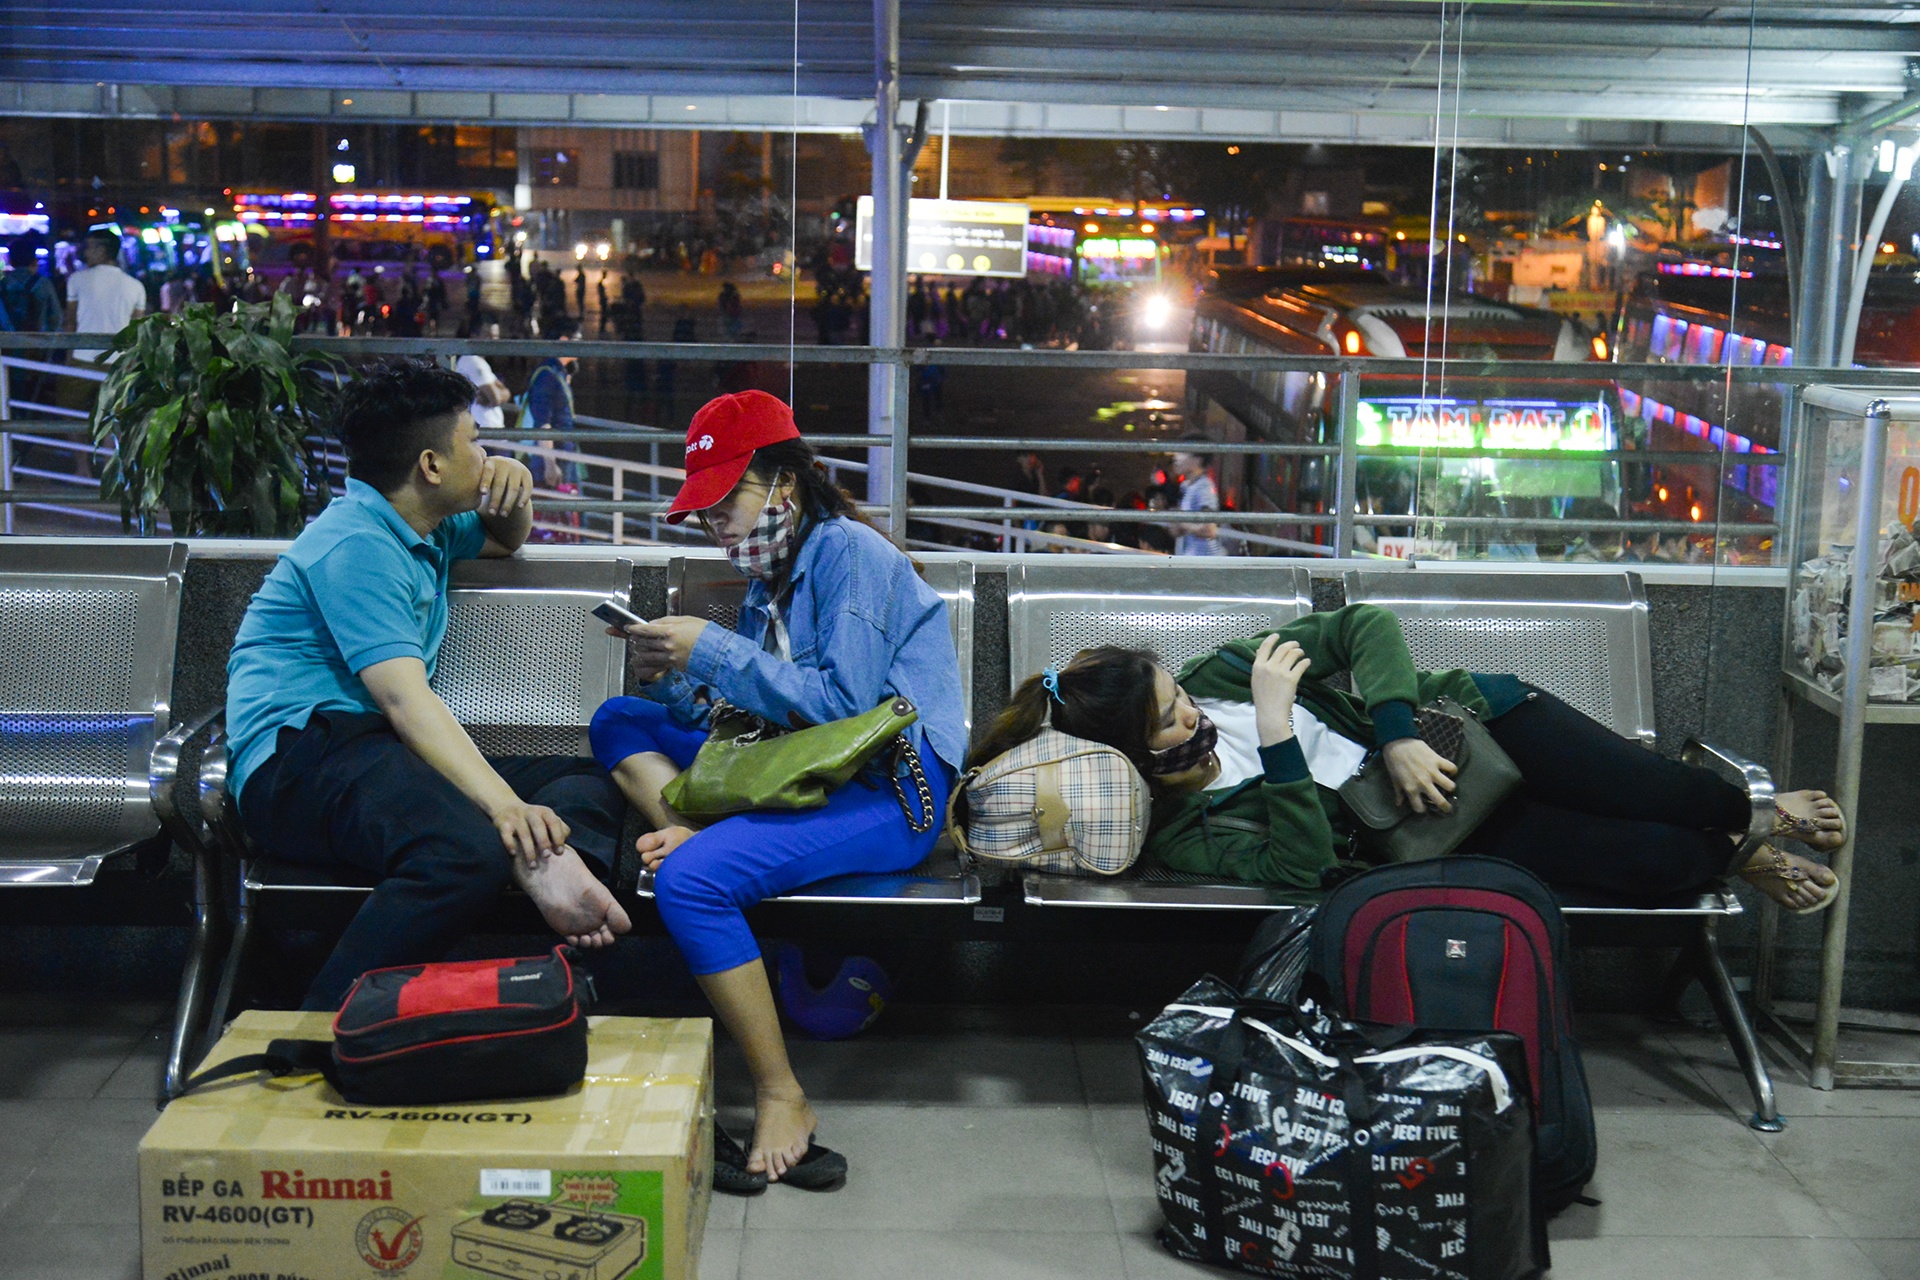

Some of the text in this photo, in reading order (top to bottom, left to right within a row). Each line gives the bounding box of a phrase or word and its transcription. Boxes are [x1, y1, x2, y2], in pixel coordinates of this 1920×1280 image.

[1168, 1089, 1199, 1111] JECI
[1240, 1083, 1271, 1103] FIVE
[1294, 1087, 1326, 1110] FIVE
[323, 1109, 533, 1125] RV-4600(GT)
[1437, 1104, 1461, 1117] FIVE
[1391, 1124, 1459, 1141] JECI FIVE
[1249, 1146, 1278, 1166] JECI
[162, 1172, 244, 1198] BẾP GA
[260, 1169, 393, 1200] Rinnai
[1214, 1165, 1262, 1193] ECI FIVE
[1174, 1190, 1201, 1213] FIVE
[1435, 1193, 1465, 1208] FIVE
[162, 1205, 315, 1229] RV-4600(GT)
[1238, 1214, 1263, 1236] FIVE
[1301, 1212, 1330, 1229] JECI
[1312, 1243, 1343, 1259] FIVE
